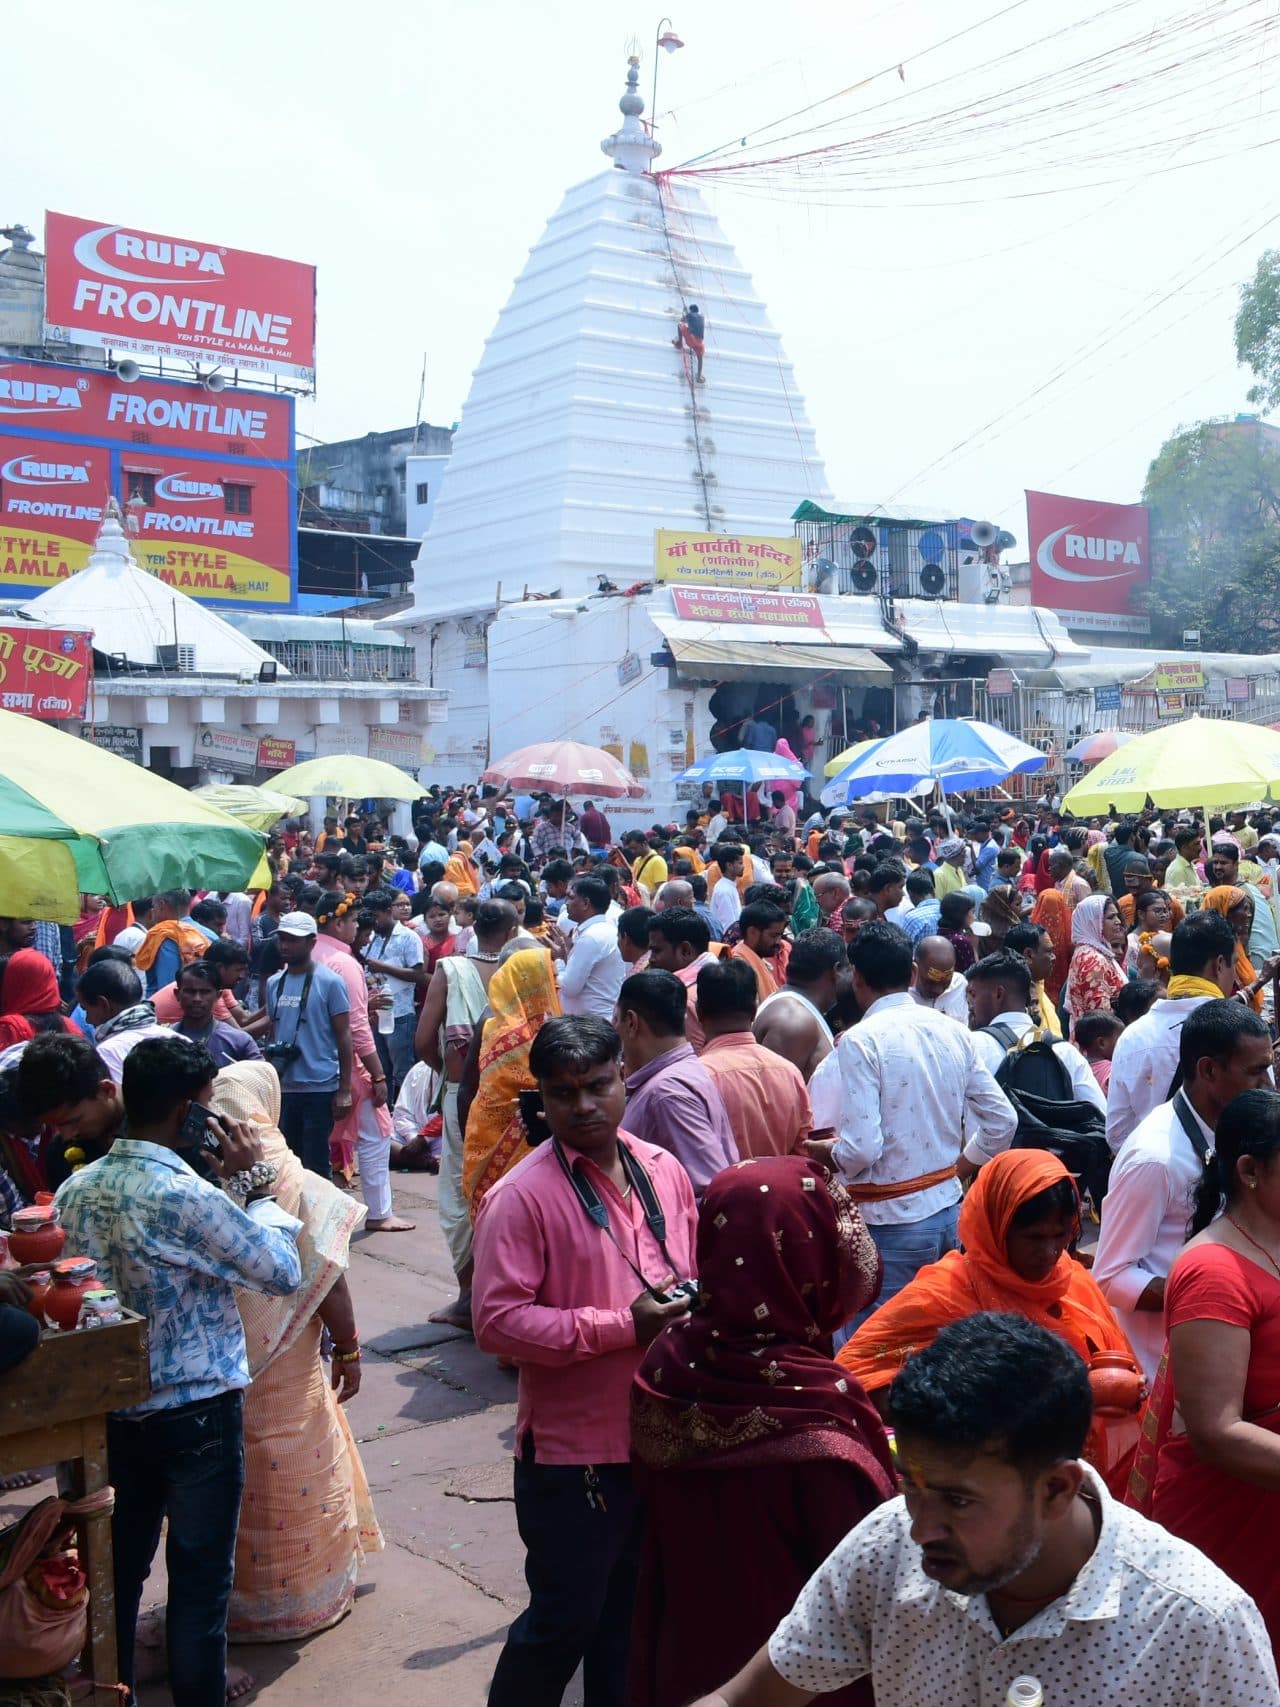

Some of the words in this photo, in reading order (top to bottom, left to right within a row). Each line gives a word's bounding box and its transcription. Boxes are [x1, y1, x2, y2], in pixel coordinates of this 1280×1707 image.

[115, 233, 225, 275] RUPA
[73, 279, 292, 345] FRONTLINE
[193, 335, 223, 347] STYLE
[238, 342, 274, 355] MAMLA
[107, 392, 268, 439] FRONTLINE
[20, 461, 90, 483] RUPA
[171, 479, 225, 498] RUPA
[7, 499, 102, 523] FRONTLINE
[143, 512, 255, 538] FRONTLINE
[0, 536, 60, 557] TYLE
[691, 538, 743, 554] पार्वती
[1065, 534, 1141, 565] RUPA
[0, 557, 70, 578] AMLA
[146, 554, 165, 565] YEH
[167, 550, 228, 570] STYLE
[158, 570, 235, 590] MAMLA
[22, 644, 84, 679] पूजा
[2, 692, 35, 709] सभा
